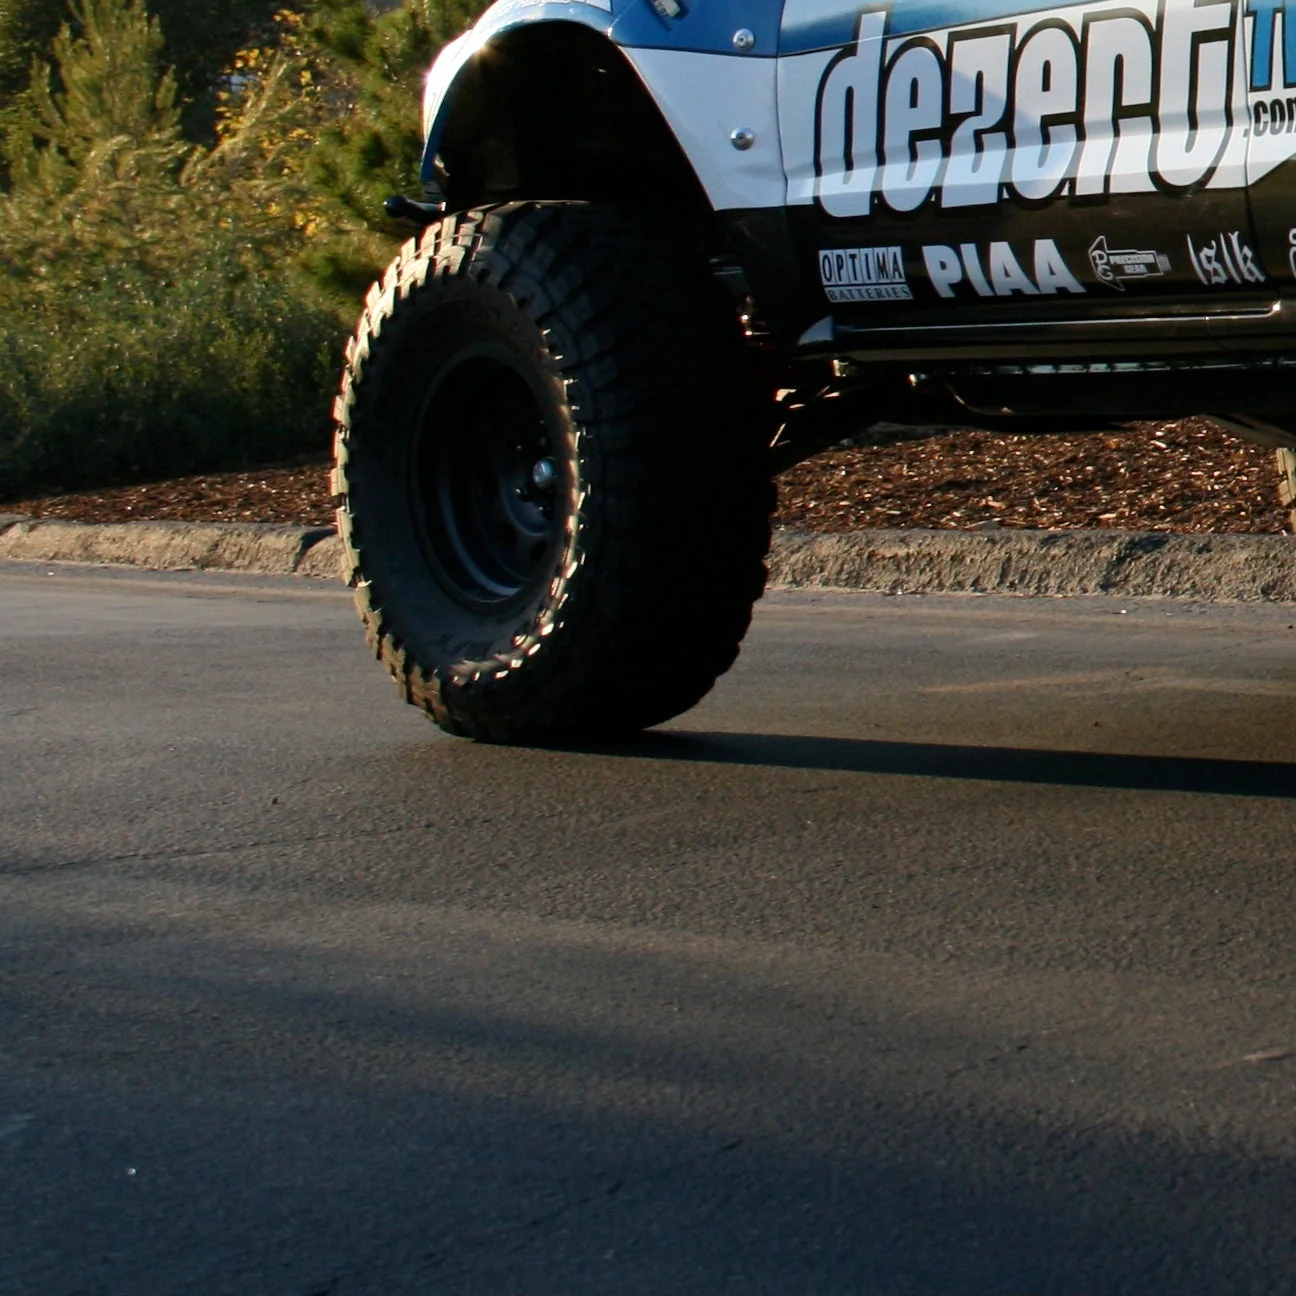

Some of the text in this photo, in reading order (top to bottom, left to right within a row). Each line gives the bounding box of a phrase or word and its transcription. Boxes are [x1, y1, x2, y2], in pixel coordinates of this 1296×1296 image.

[820, 249, 902, 284] OPTIMA
[921, 238, 1087, 299] PIAA
[827, 284, 912, 301] BATTERIES
